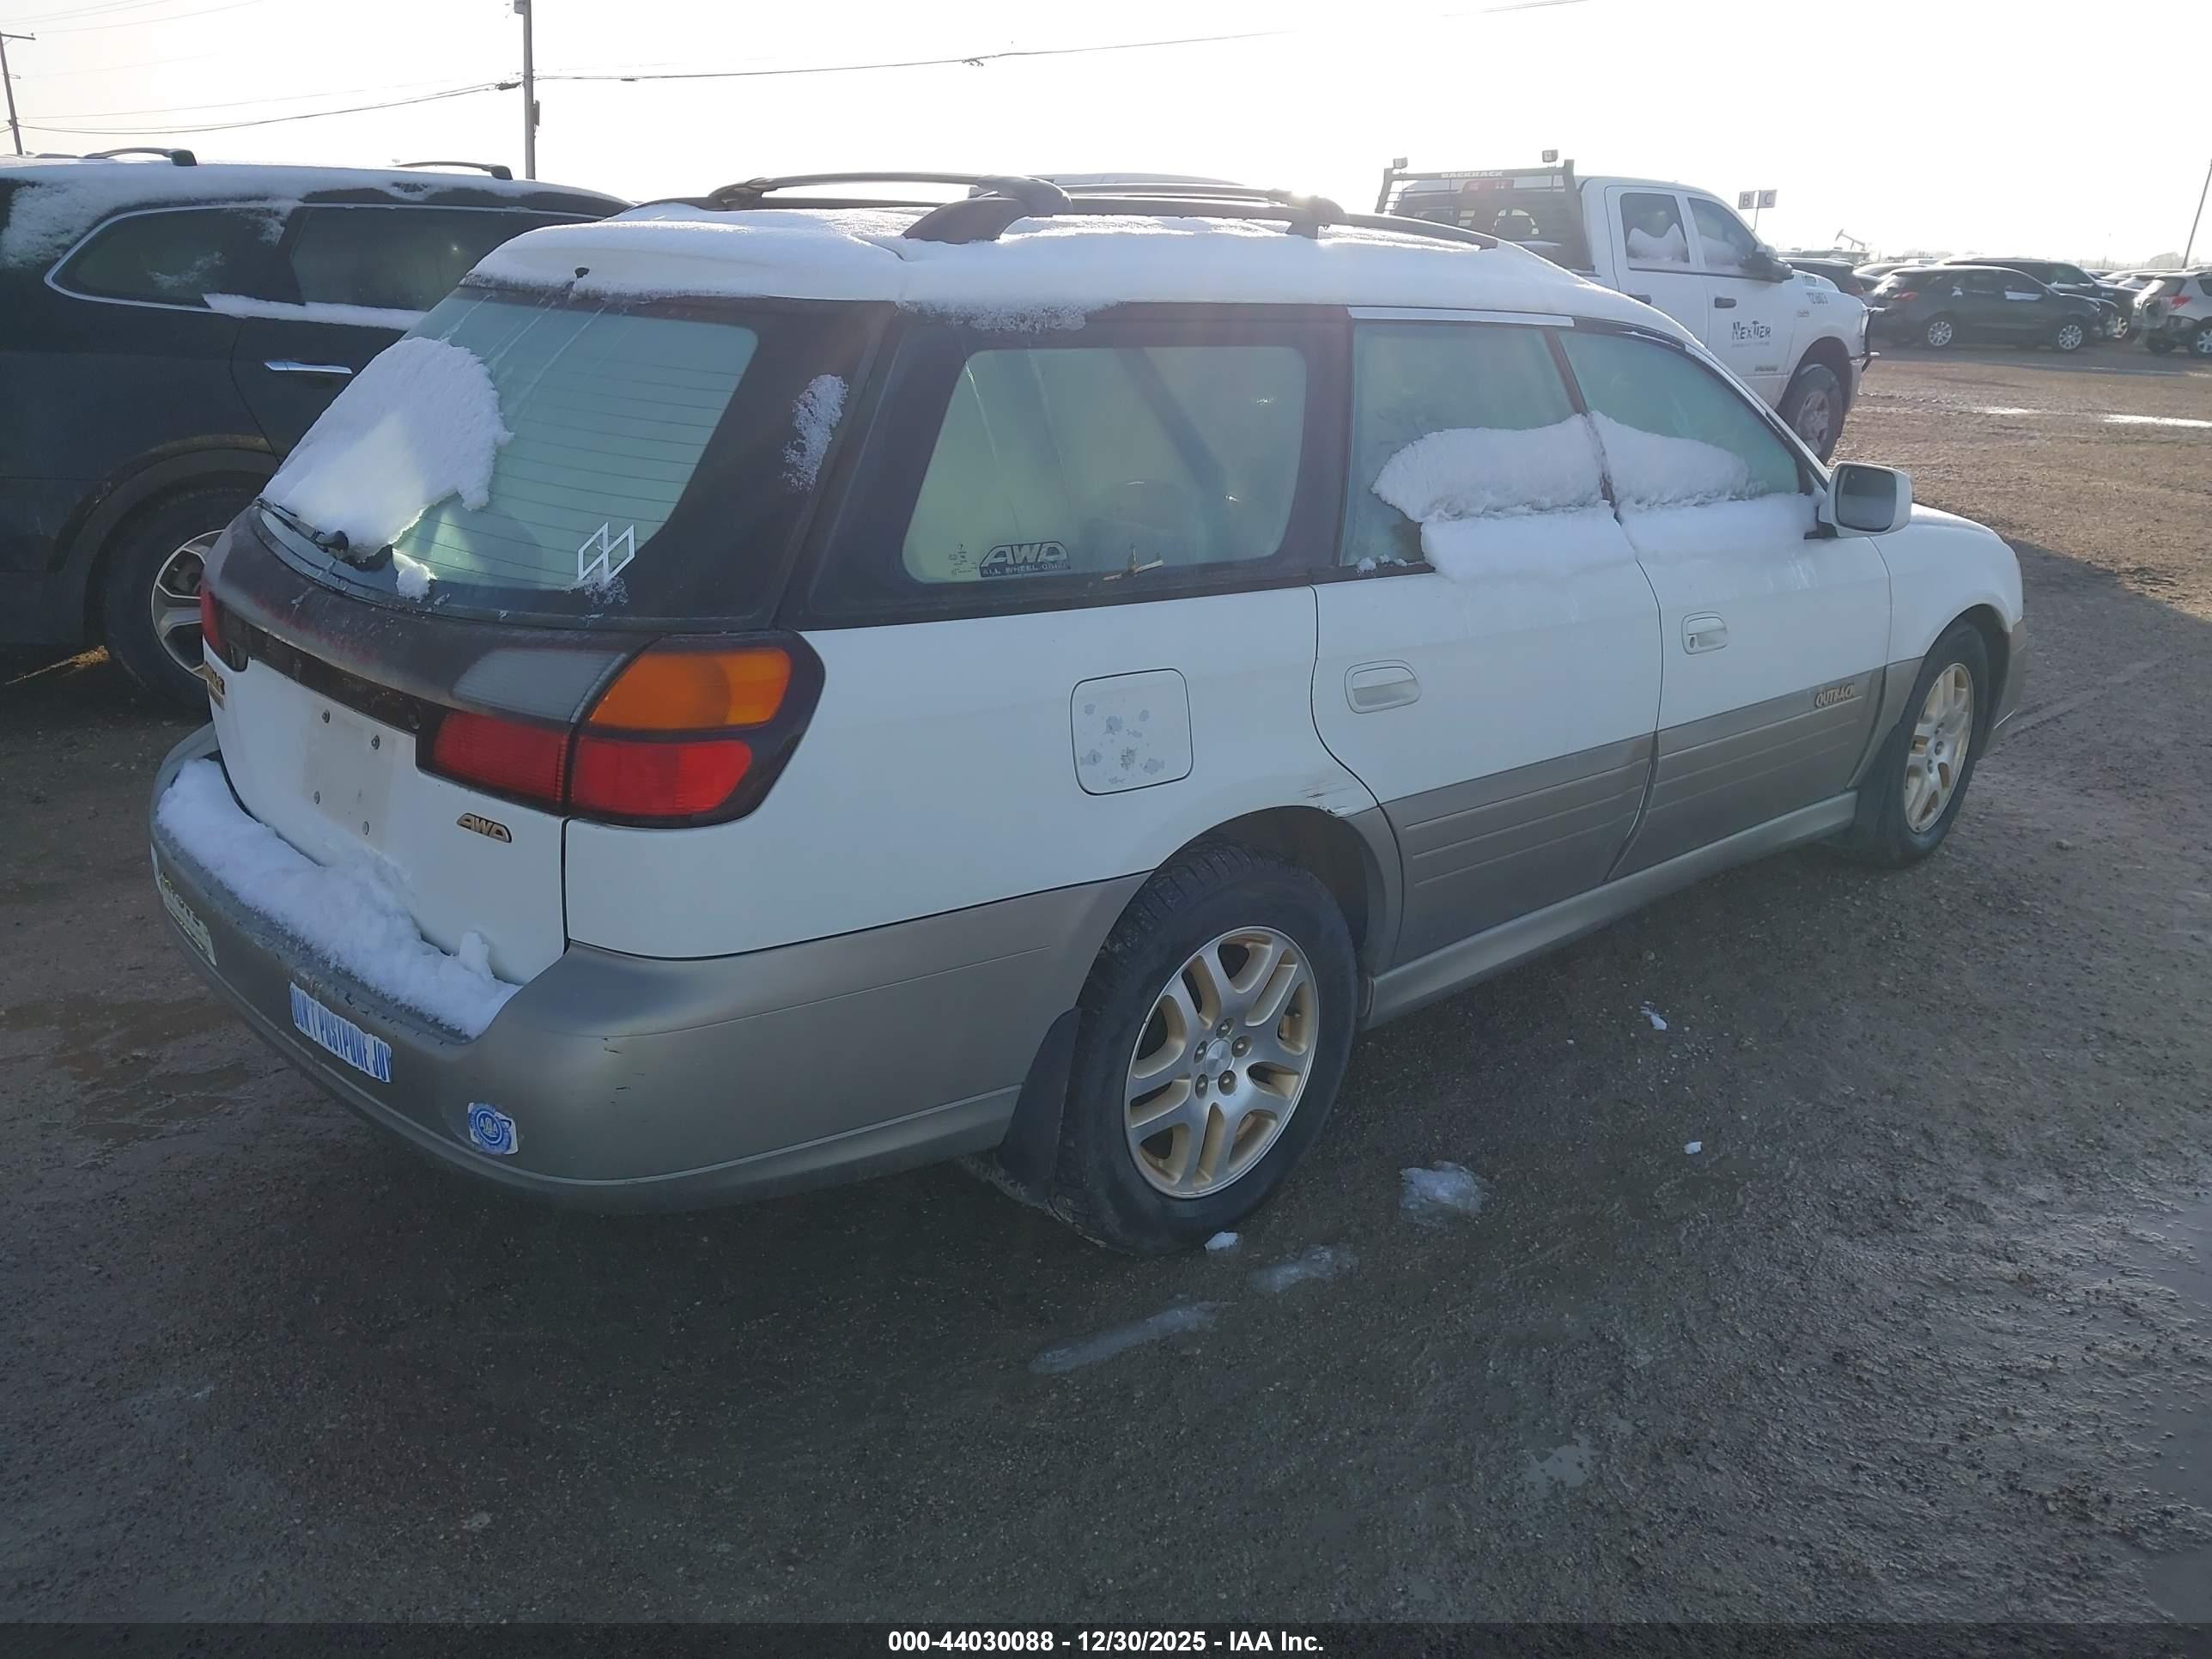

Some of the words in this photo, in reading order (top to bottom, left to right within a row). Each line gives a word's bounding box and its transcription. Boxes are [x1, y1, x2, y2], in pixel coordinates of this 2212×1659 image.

[1743, 193, 1751, 207] B
[1765, 192, 1772, 205] C
[980, 542, 1068, 567] AWD
[982, 567, 1001, 575] ALL
[1005, 563, 1039, 574] WHEEL
[457, 813, 512, 842] AWD
